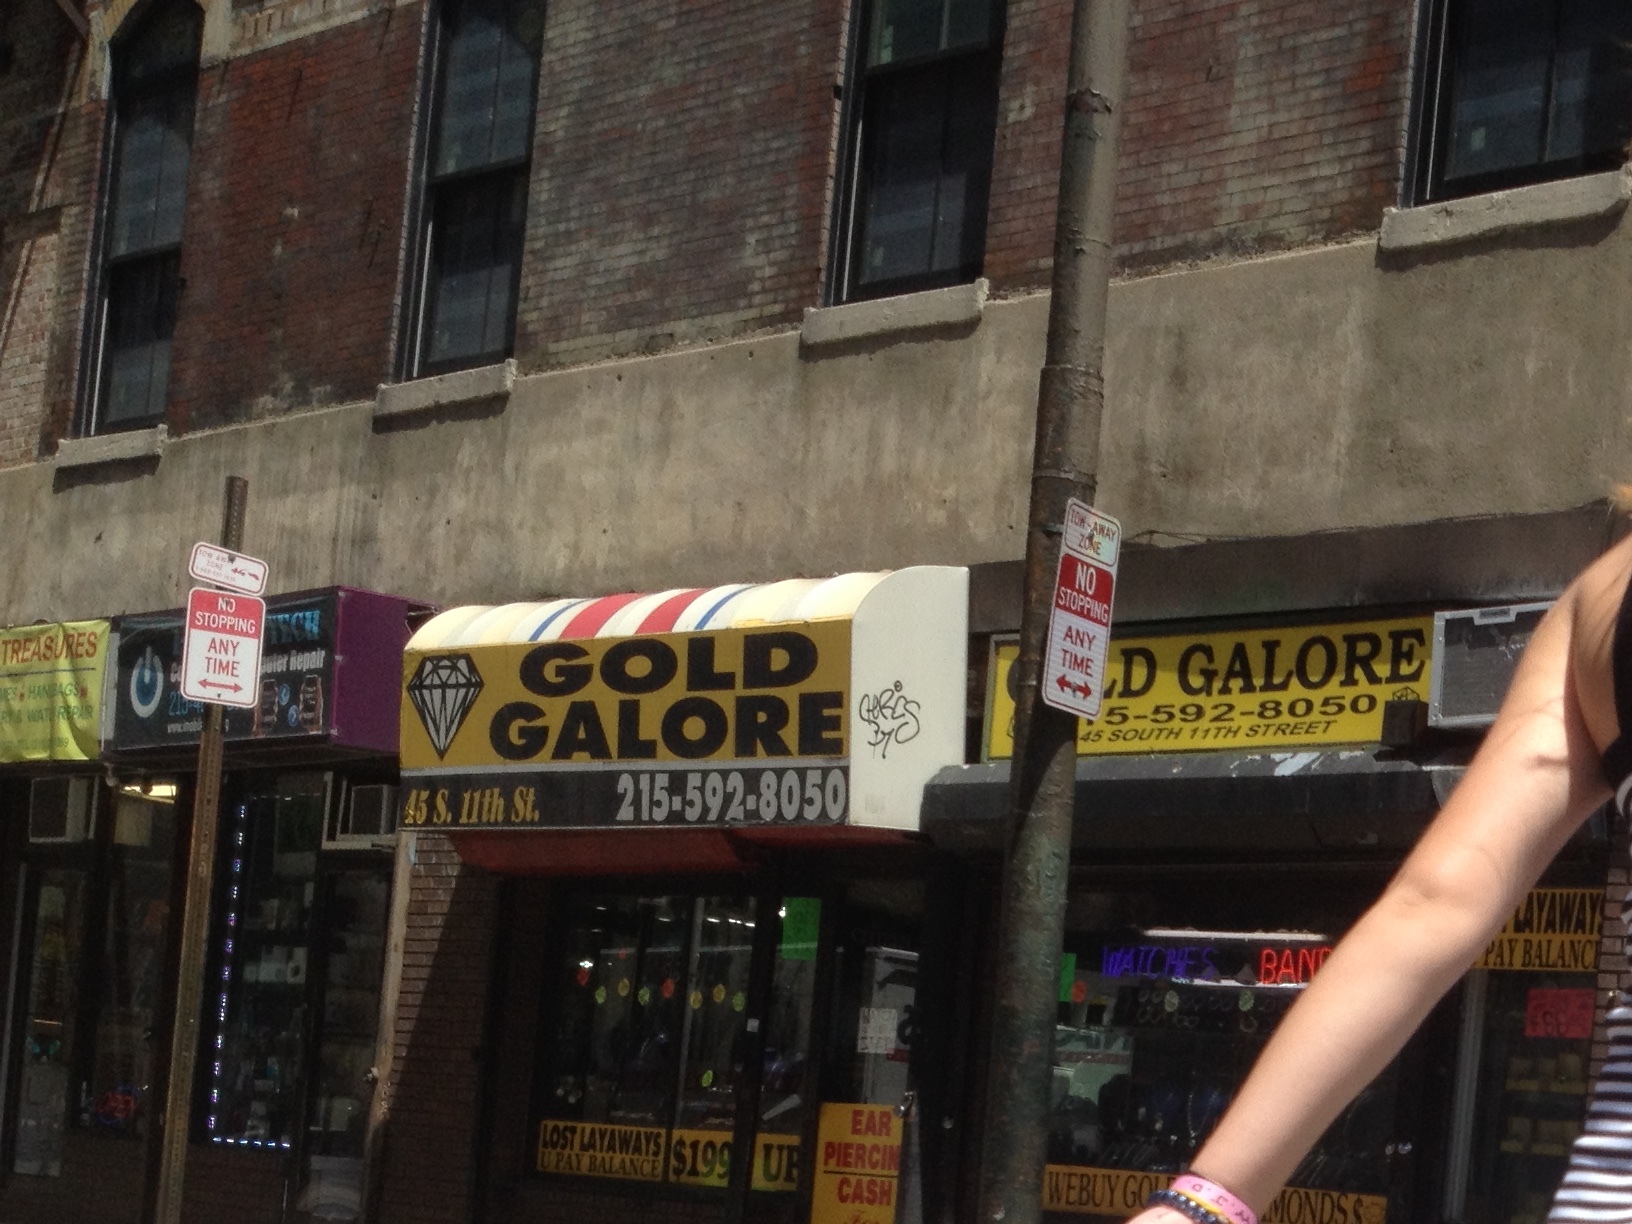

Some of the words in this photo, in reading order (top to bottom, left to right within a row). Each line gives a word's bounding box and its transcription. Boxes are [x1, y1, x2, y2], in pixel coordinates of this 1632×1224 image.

[1078, 533, 1102, 556] ZONE
[1075, 561, 1097, 596] NO
[218, 597, 236, 613] NO
[1058, 586, 1109, 622] STOPPING
[195, 610, 256, 634] STOPPING
[2, 631, 98, 665] TREASURES
[207, 637, 240, 657] ANY
[1063, 625, 1097, 652] ANY
[205, 657, 240, 678] TIME
[519, 630, 819, 698] GOLD
[1061, 648, 1094, 678] TIME
[1177, 629, 1427, 699] GALORE
[489, 690, 845, 761] GALORE
[1080, 728, 1102, 744] 45
[1107, 725, 1180, 743] SOUTH
[1188, 723, 1240, 741] 11TH
[1243, 719, 1338, 739] STREET
[404, 788, 428, 825] 45
[433, 788, 452, 824] S.
[459, 787, 505, 823] 11th
[510, 784, 540, 823] St.
[616, 768, 847, 823] 215-592-8050
[1513, 891, 1602, 935] LAYAWAY
[851, 1109, 893, 1137] EAR
[543, 1122, 577, 1151] LOST
[580, 1126, 662, 1158] LAYAWAYS
[555, 1153, 584, 1173] PAY
[587, 1154, 661, 1179] BALANCE
[823, 1141, 900, 1171] PIERCIN
[837, 1176, 893, 1207] CASH
